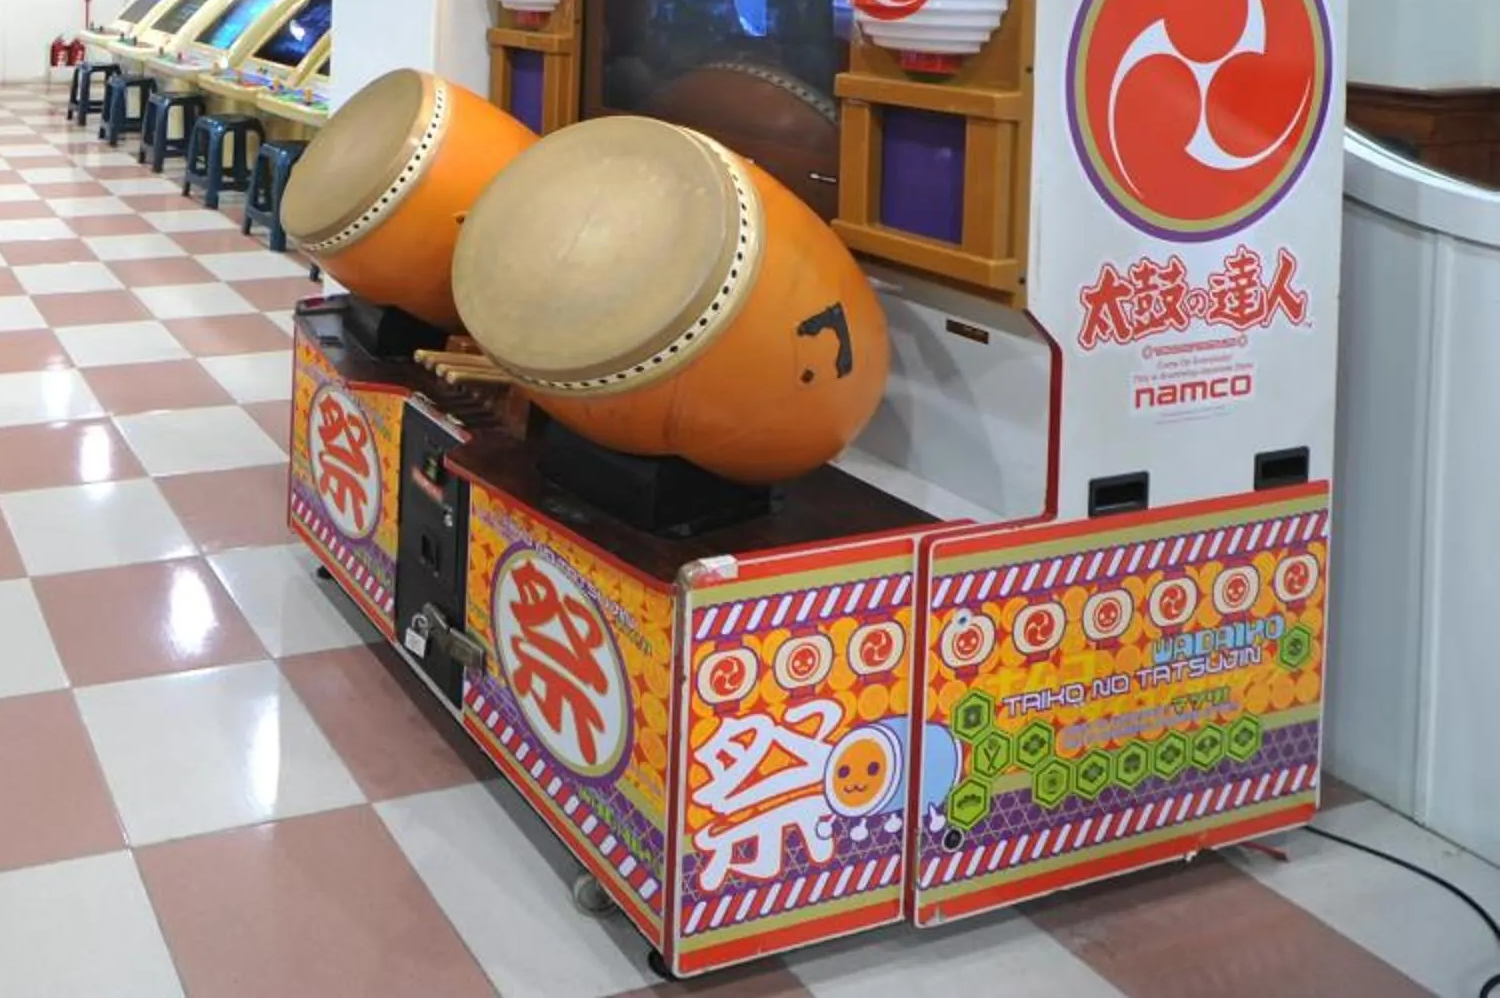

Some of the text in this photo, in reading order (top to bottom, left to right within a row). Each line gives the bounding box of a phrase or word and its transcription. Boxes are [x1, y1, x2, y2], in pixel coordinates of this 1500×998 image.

[1078, 244, 1307, 350] 太鼓の達人
[1135, 374, 1252, 409] namco
[1152, 614, 1286, 665] WADAIKO
[1002, 682, 1085, 719] TAIKO
[1091, 673, 1132, 700] NO
[1137, 646, 1262, 691] TATSUJIN
